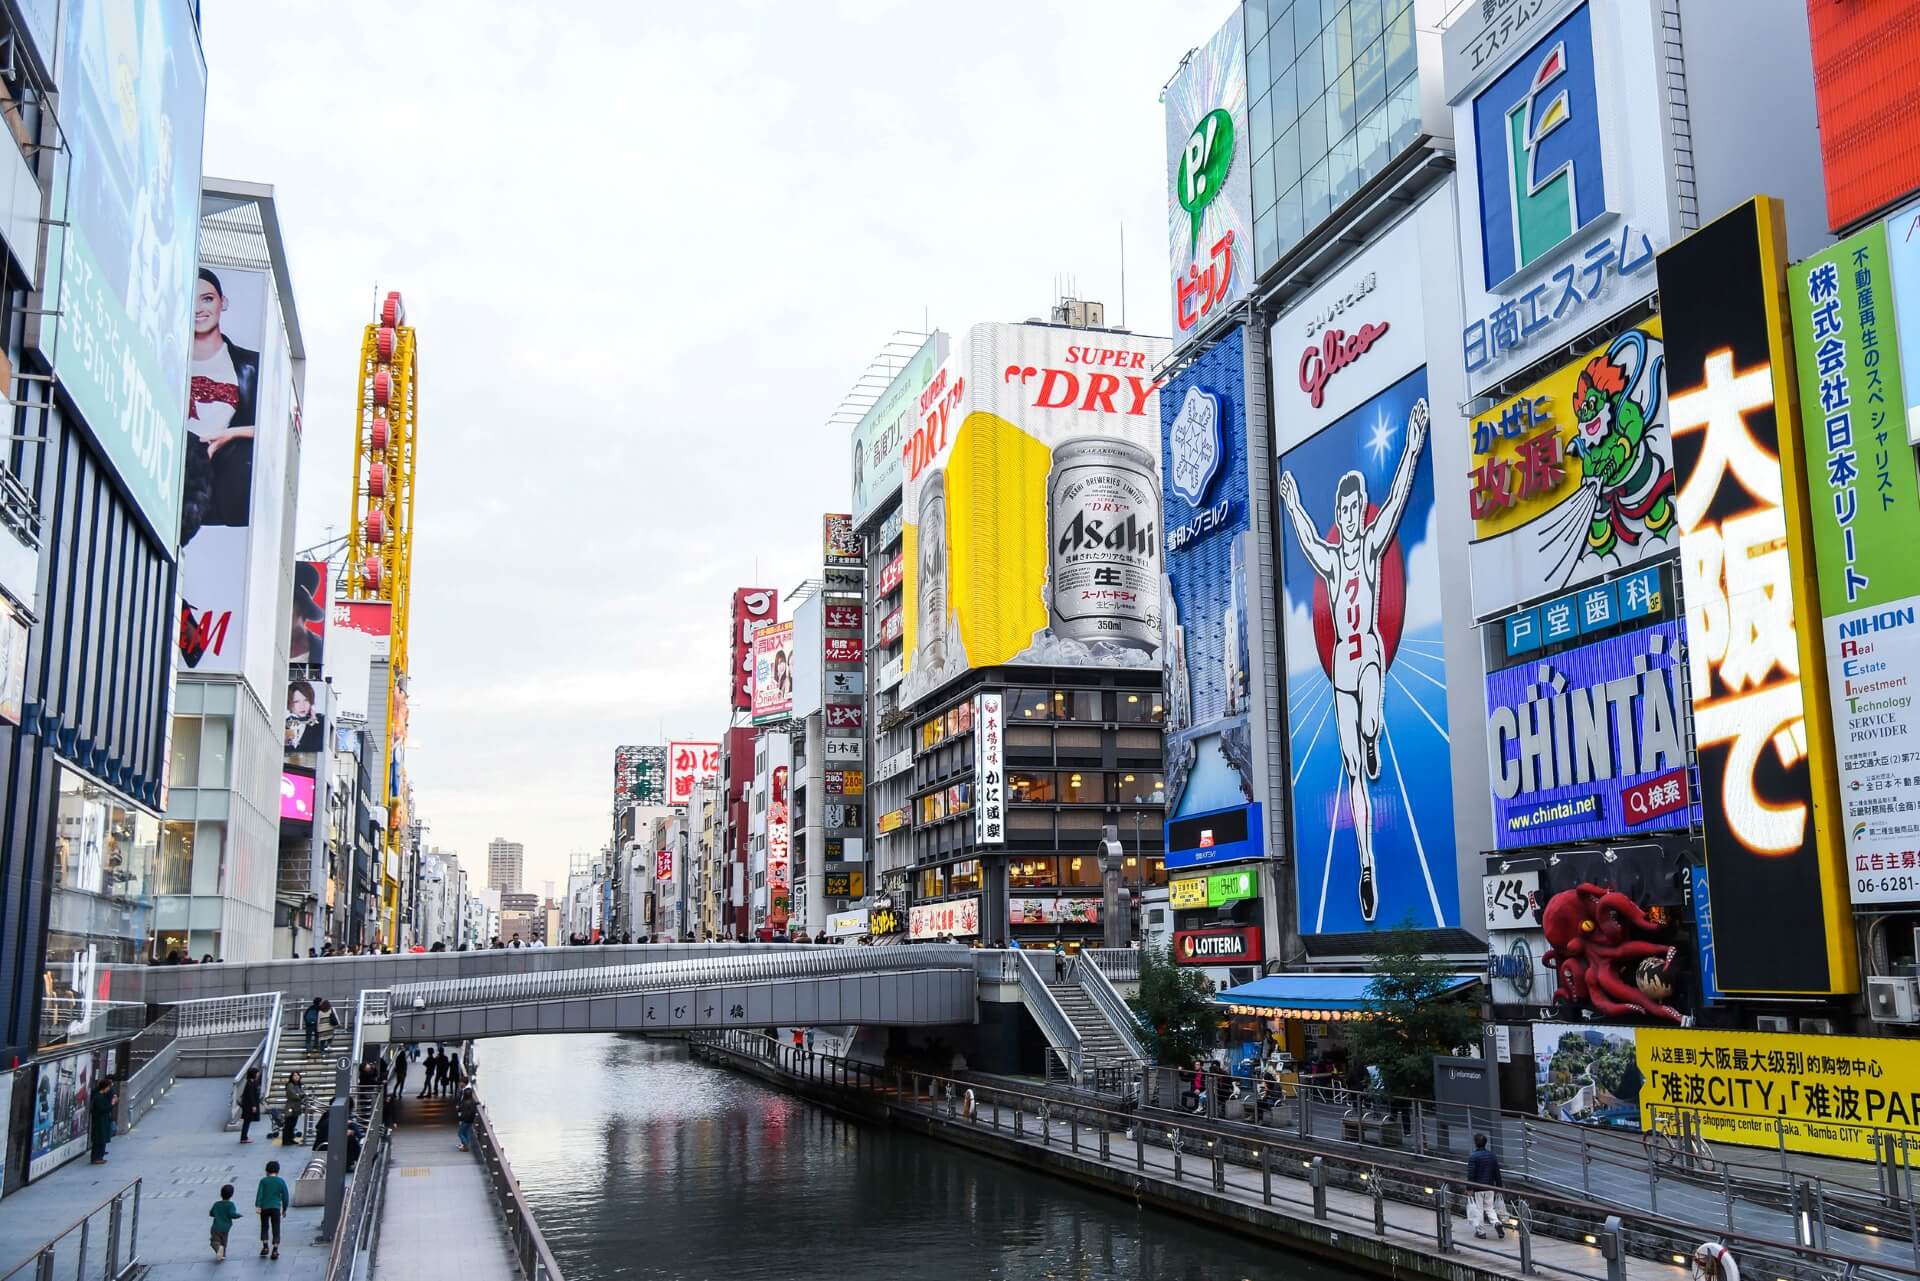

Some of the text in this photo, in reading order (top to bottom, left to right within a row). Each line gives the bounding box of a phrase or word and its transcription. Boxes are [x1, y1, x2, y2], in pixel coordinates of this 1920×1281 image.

[1177, 229, 1235, 331] ピップ
[1463, 225, 1654, 373] 日商エステム
[1065, 345, 1146, 369] SUPER
[1299, 321, 1390, 408] Glico
[919, 367, 947, 417] SUPER
[1852, 246, 1895, 511] 不動産再生のスペシャリスト
[1473, 394, 1551, 455] かぜに
[1808, 262, 1868, 603] 株式会社日本リート
[1085, 476, 1121, 487] BREWERIES
[1468, 425, 1566, 521] 改源
[1060, 510, 1154, 561] Asahi
[1167, 500, 1229, 551] 雪印メグミルク
[1094, 567, 1122, 586] 生
[1081, 590, 1137, 602] スーパードライ
[1650, 597, 1659, 610] 3F
[1669, 347, 1807, 857] 大阪で
[1345, 570, 1362, 661] グリコ
[1513, 575, 1651, 647] 戸堂歯科
[1839, 607, 1915, 639] NIHON
[1097, 620, 1122, 631] 350ml
[1841, 640, 1874, 658] Real
[1843, 659, 1886, 677] Estate
[1845, 676, 1907, 696] Investment
[1845, 695, 1912, 714] Technology
[1849, 712, 1896, 730] SERVICE
[1851, 724, 1908, 742] PROVIDER
[676, 749, 720, 772] かに
[828, 741, 861, 754] 白木屋
[985, 770, 1001, 838] かに道楽
[1649, 779, 1681, 810] 検索
[1494, 879, 1529, 920] くくる
[1195, 936, 1242, 954] LOTTERIA
[647, 1004, 744, 1020] えびす橋
[1703, 1113, 1736, 1131] shopping
[1738, 1118, 1762, 1131] center
[1764, 1122, 1772, 1132] in
